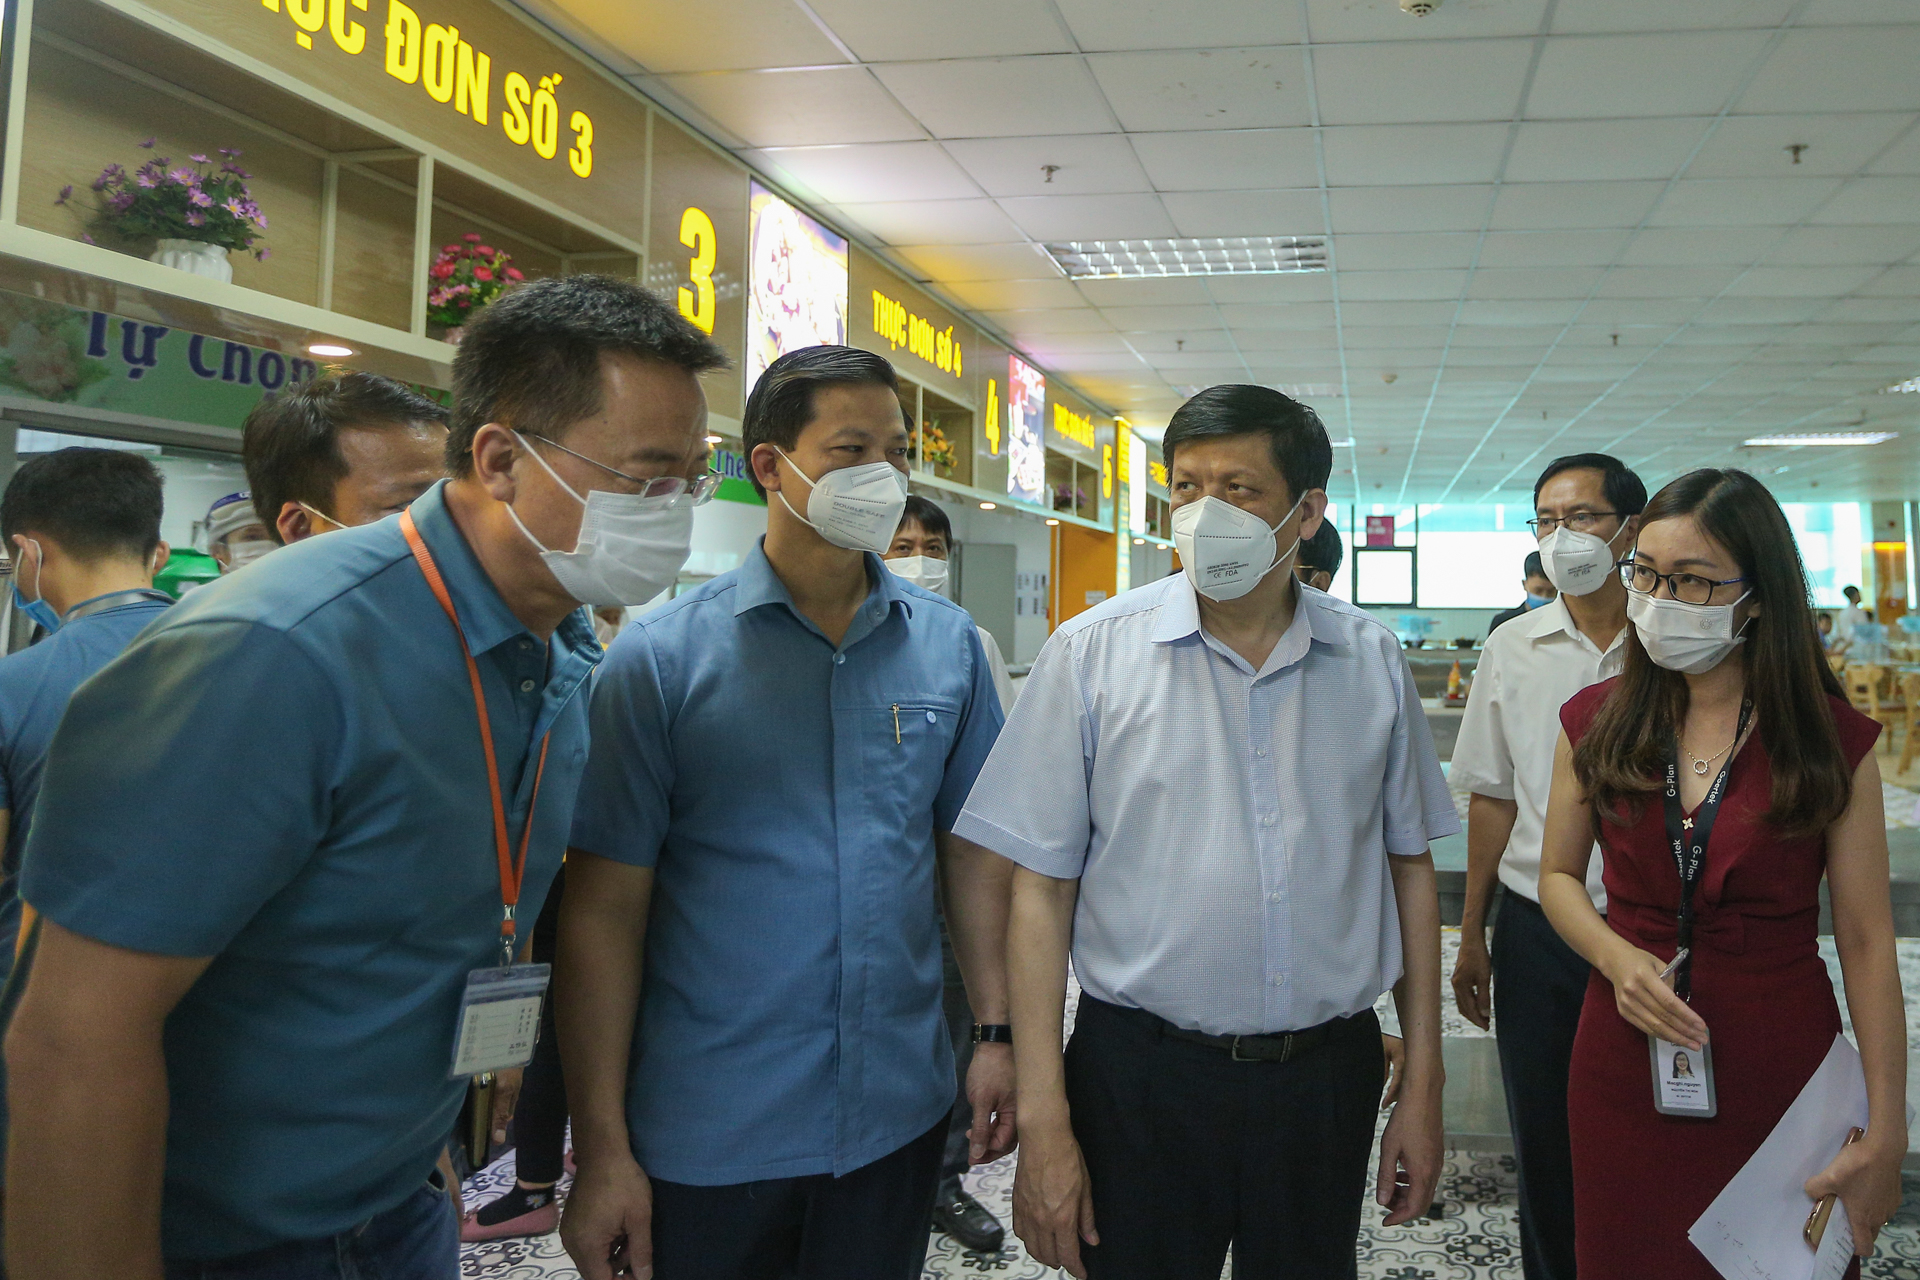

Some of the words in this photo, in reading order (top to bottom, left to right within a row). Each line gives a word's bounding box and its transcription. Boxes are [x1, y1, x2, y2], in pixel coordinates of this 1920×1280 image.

[385, 0, 491, 126] ĐƠN
[503, 72, 563, 160] SỐ
[569, 111, 594, 179] 3
[678, 207, 716, 336] 3
[872, 289, 907, 351] THỰC
[908, 313, 935, 364] ĐƠN
[936, 325, 953, 373] SỐ
[953, 342, 962, 378] 4
[985, 378, 1000, 455] 4
[1102, 444, 1113, 499] 5
[833, 501, 865, 513] DOUBLE
[866, 509, 886, 518] SAFE
[1225, 569, 1239, 577] FDA
[1666, 764, 1676, 797] G-Plan
[1707, 770, 1726, 805] Goertek
[1687, 845, 1702, 881] G-Plan
